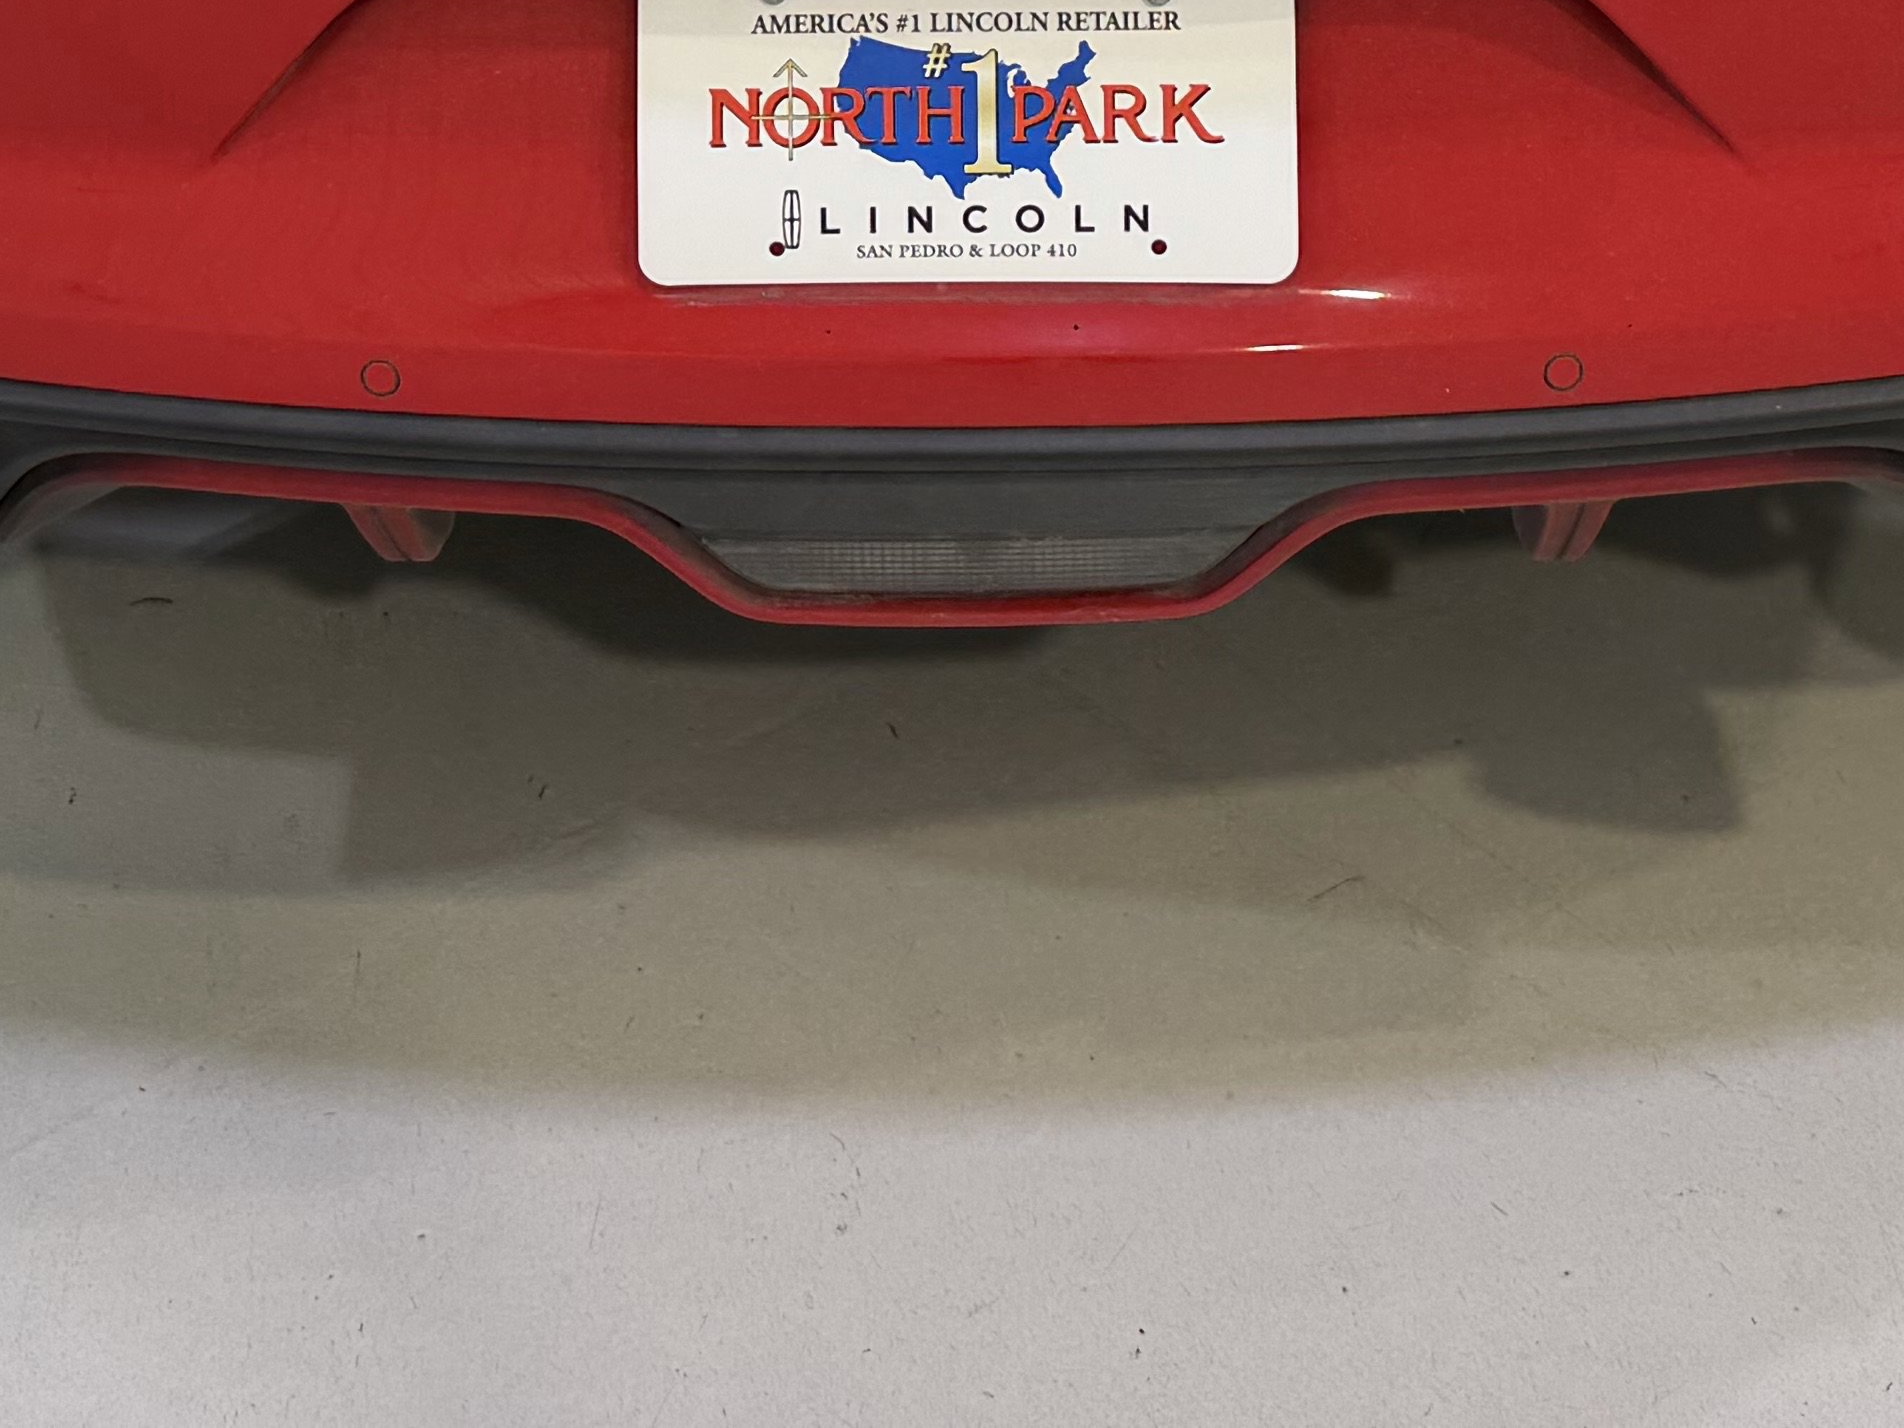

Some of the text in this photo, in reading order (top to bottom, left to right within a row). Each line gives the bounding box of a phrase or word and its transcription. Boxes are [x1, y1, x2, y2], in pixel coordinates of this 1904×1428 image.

[751, 10, 1182, 35] AMERICA'S #1 LINCOLN RETAILER
[708, 84, 1226, 149] NORTH PARK
[821, 203, 1150, 235] LINCOLN
[856, 242, 1078, 259] SAN PEDRO & LOOP 410
